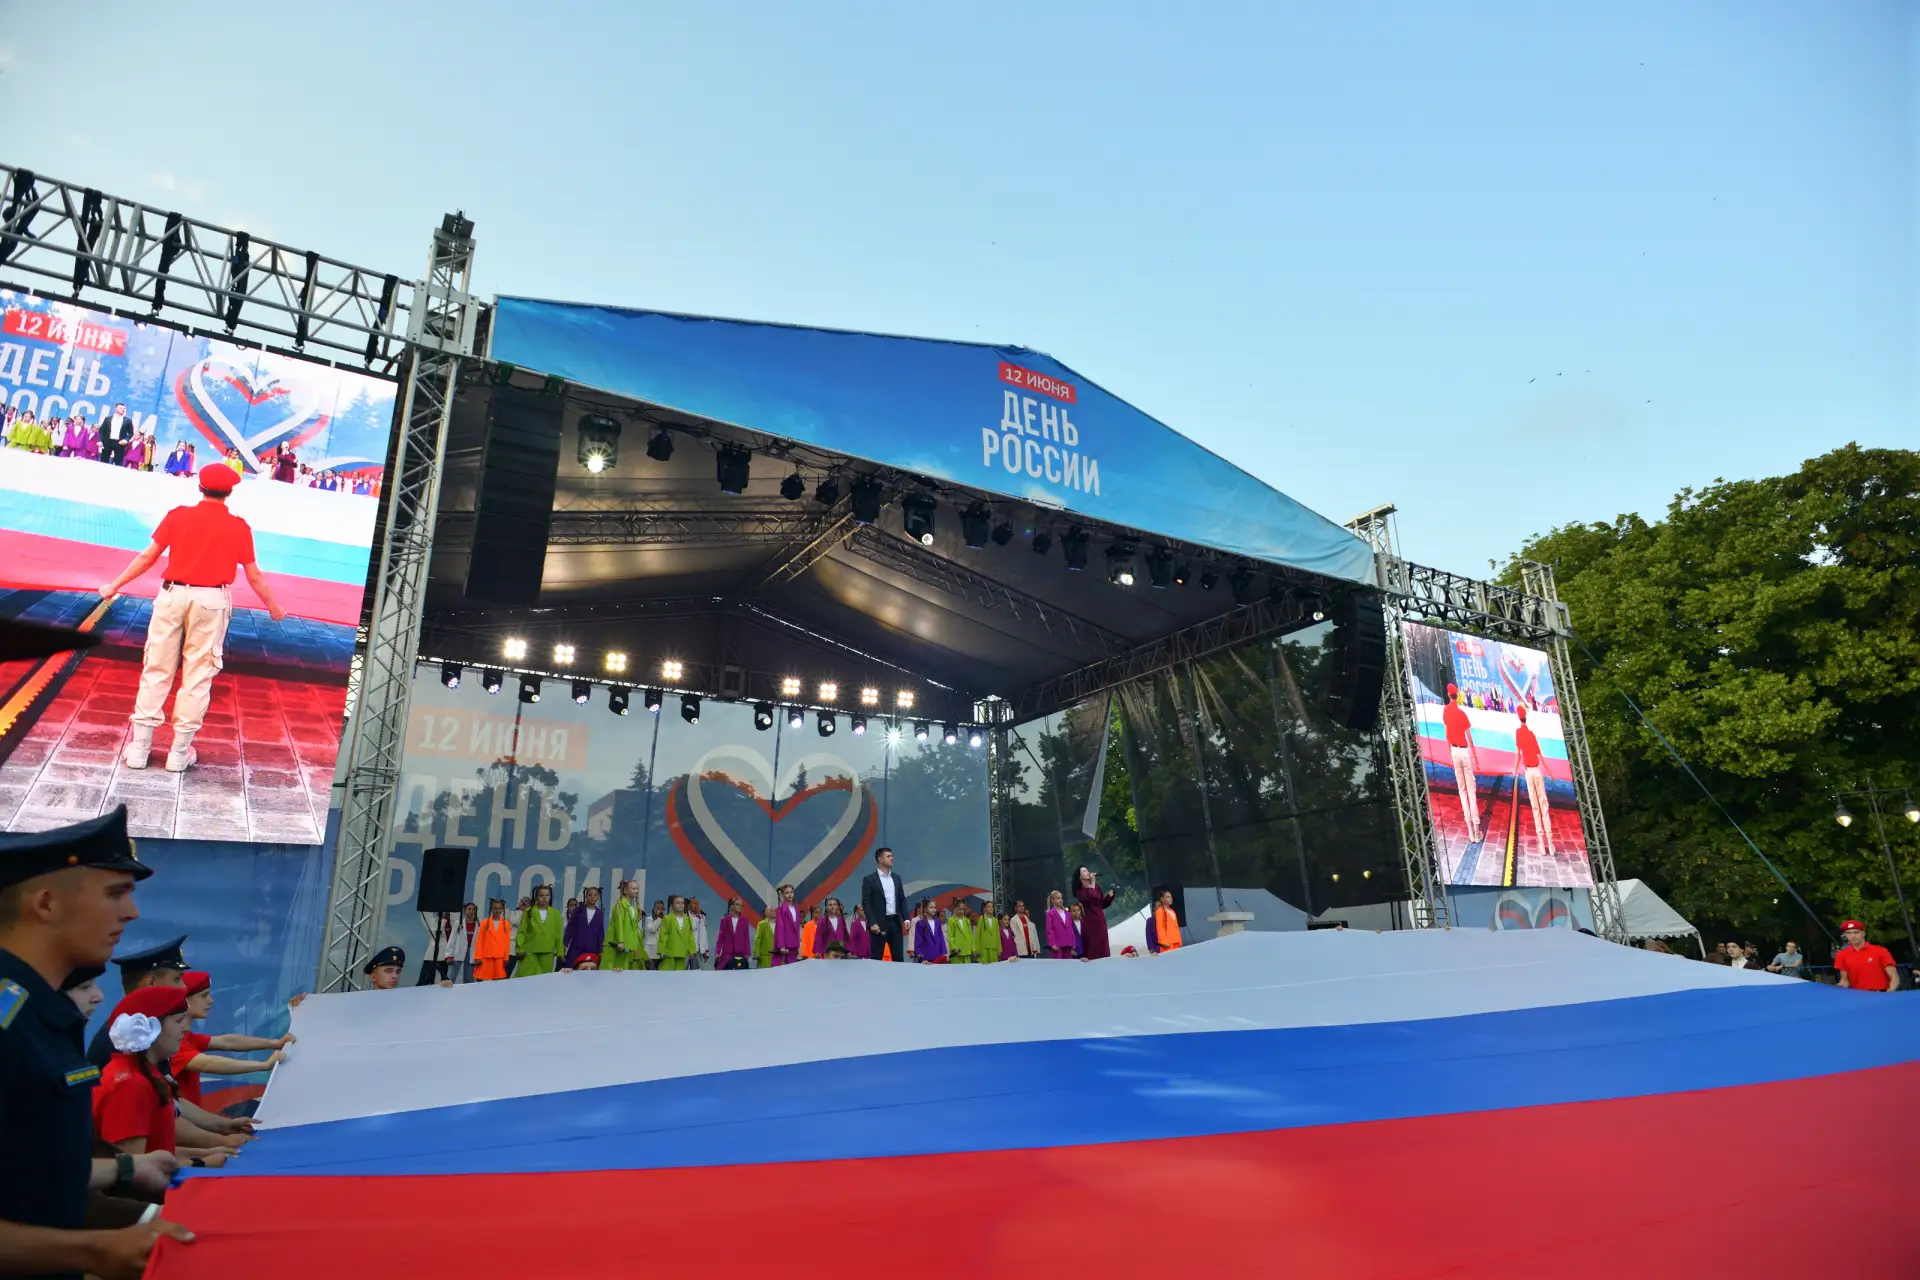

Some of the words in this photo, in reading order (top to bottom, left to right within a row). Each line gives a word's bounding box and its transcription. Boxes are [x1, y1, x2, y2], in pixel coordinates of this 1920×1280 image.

[16, 313, 43, 336] 12
[0, 342, 111, 397] ДЕНЬ
[1005, 367, 1022, 384] 12
[1026, 372, 1070, 399] ИЮНЯ
[1001, 390, 1079, 447] ДЕНЬ
[982, 427, 1100, 497] РОССИИ
[1459, 657, 1488, 679] ДЕНЬ
[418, 714, 460, 751] 12
[470, 719, 571, 762] ИЮНЯ
[388, 773, 573, 852] ДЕНЬ
